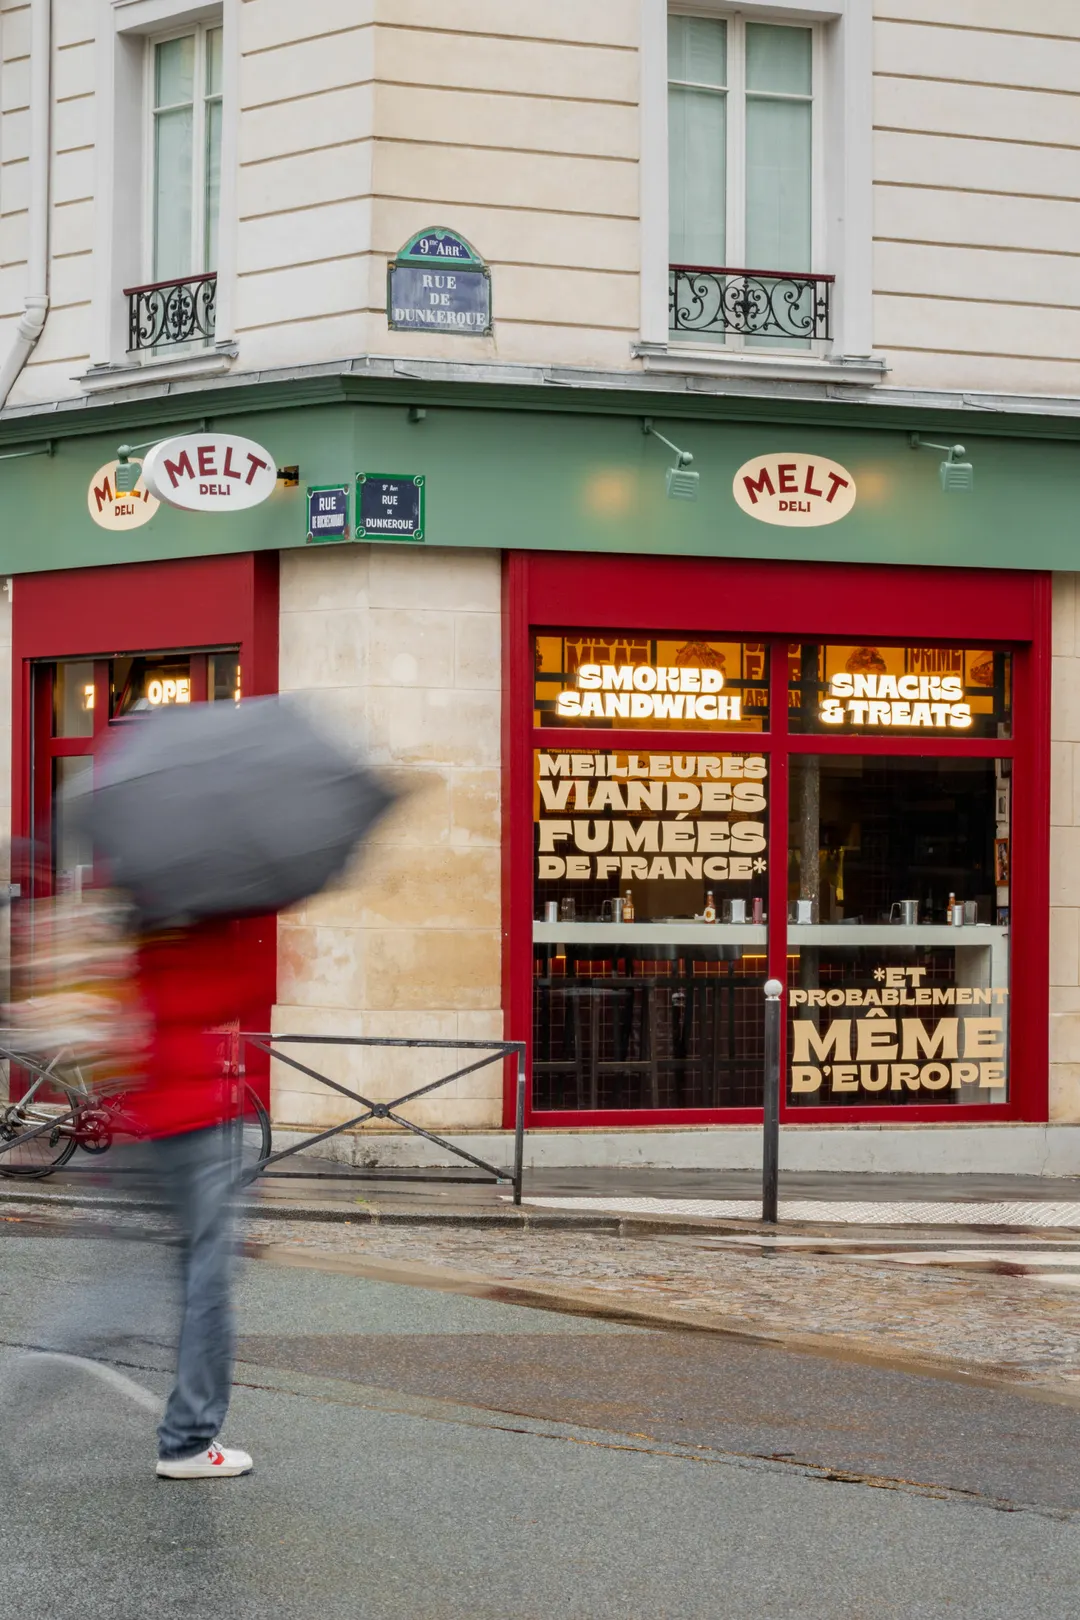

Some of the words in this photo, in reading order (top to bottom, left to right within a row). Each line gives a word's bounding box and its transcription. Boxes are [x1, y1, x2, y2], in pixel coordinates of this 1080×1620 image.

[422, 274, 457, 290] RUE
[429, 292, 450, 306] DE
[394, 308, 486, 327] DUNKERQUE
[163, 445, 267, 489] MELT
[199, 483, 231, 496] DELI
[742, 463, 849, 505] MELT
[114, 503, 135, 517] DELI
[319, 496, 337, 511] RUE
[381, 495, 398, 505] RUE
[778, 500, 811, 513] DELI
[365, 518, 414, 530] DUNKERQUE
[148, 678, 191, 704] OPE
[578, 664, 724, 693] SMOKED
[831, 673, 963, 701] SNACKS
[557, 691, 742, 721] SANDWICH
[538, 754, 768, 779] MEILLEURES
[536, 780, 767, 813] VIANDES
[538, 812, 767, 854] FUMÉES
[538, 855, 592, 880] DE
[789, 987, 1009, 1007] PROBABLEMENT
[792, 1007, 1005, 1062] MÊME
[791, 1061, 1005, 1093] D'EUROPE
